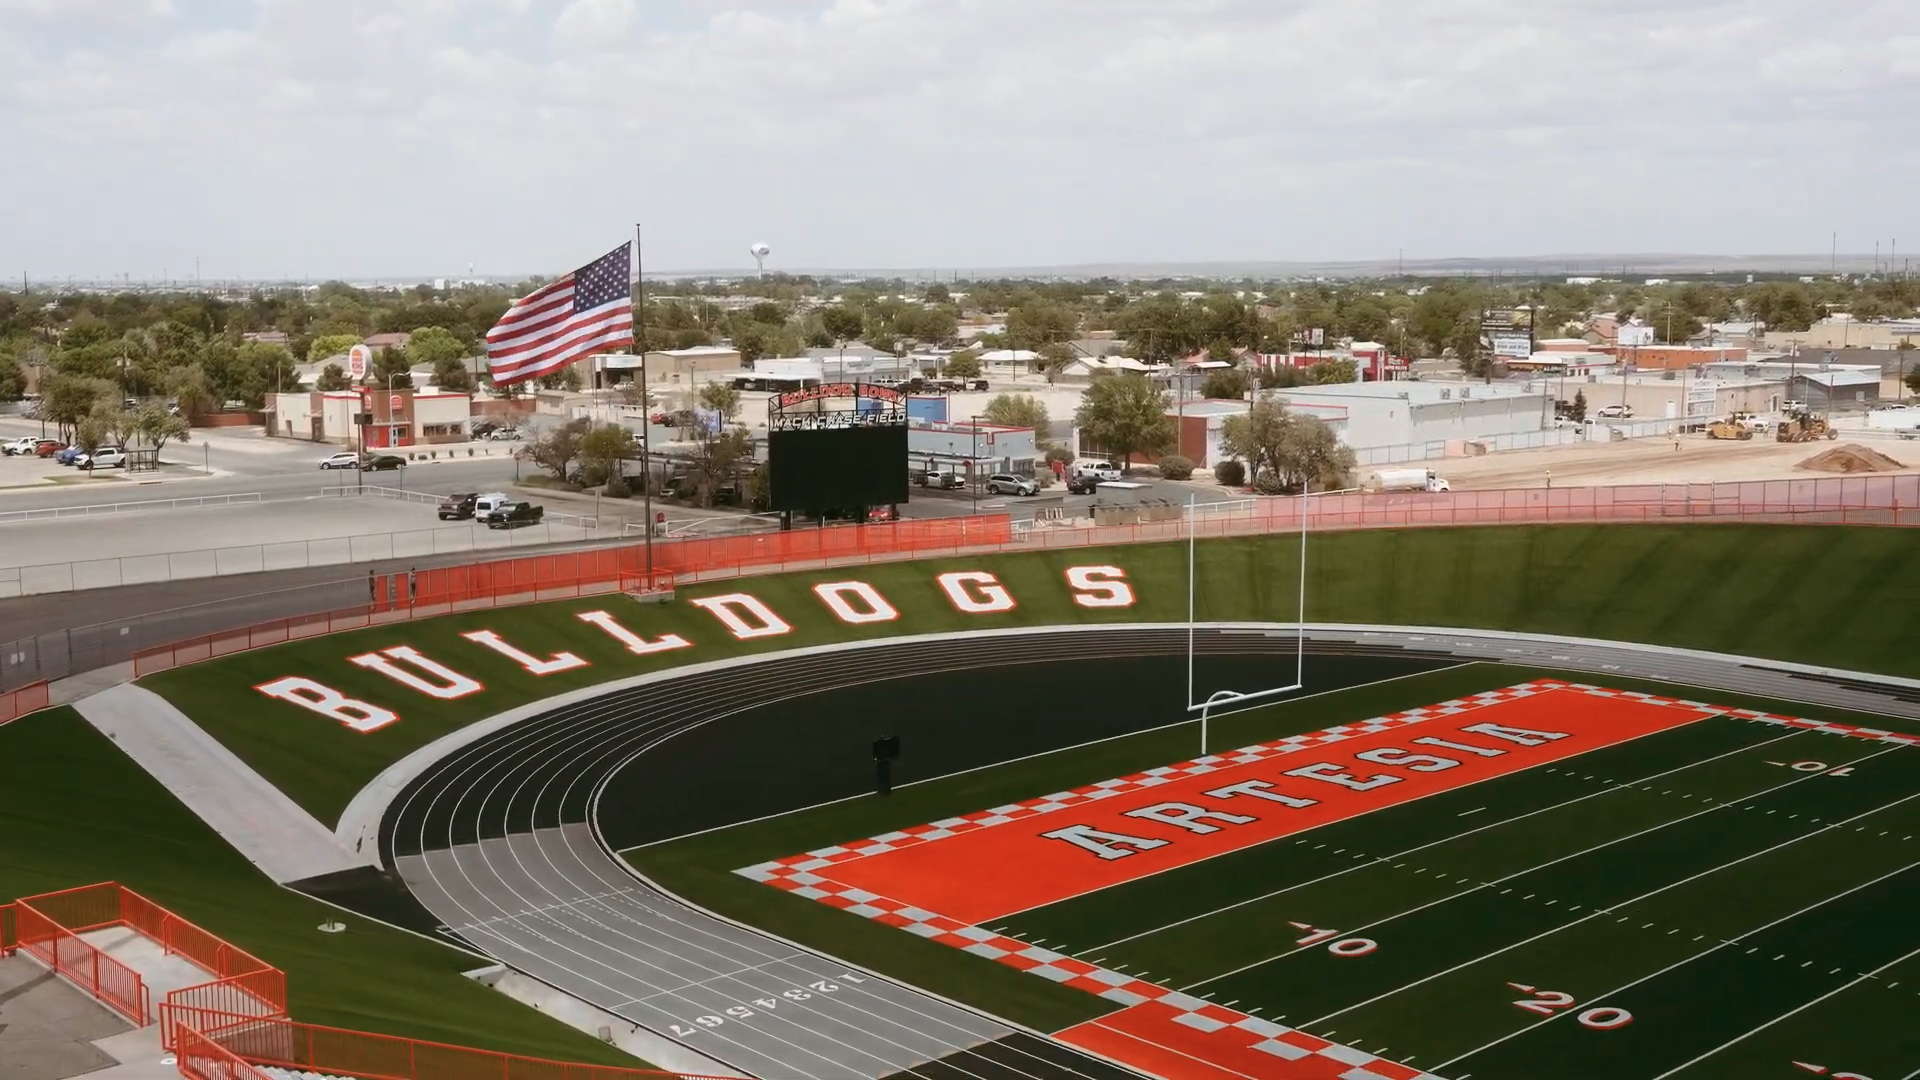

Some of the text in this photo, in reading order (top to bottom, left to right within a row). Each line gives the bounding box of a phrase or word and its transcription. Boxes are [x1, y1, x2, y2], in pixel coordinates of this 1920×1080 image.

[781, 384, 899, 404] BULLDOG BOWL
[774, 412, 906, 429] MACK CHASE FIELD
[254, 566, 1138, 733] BULLDOGS
[1039, 722, 1573, 861] ARTESIA
[1295, 928, 1378, 957] 10
[1512, 990, 1634, 1030] 20
